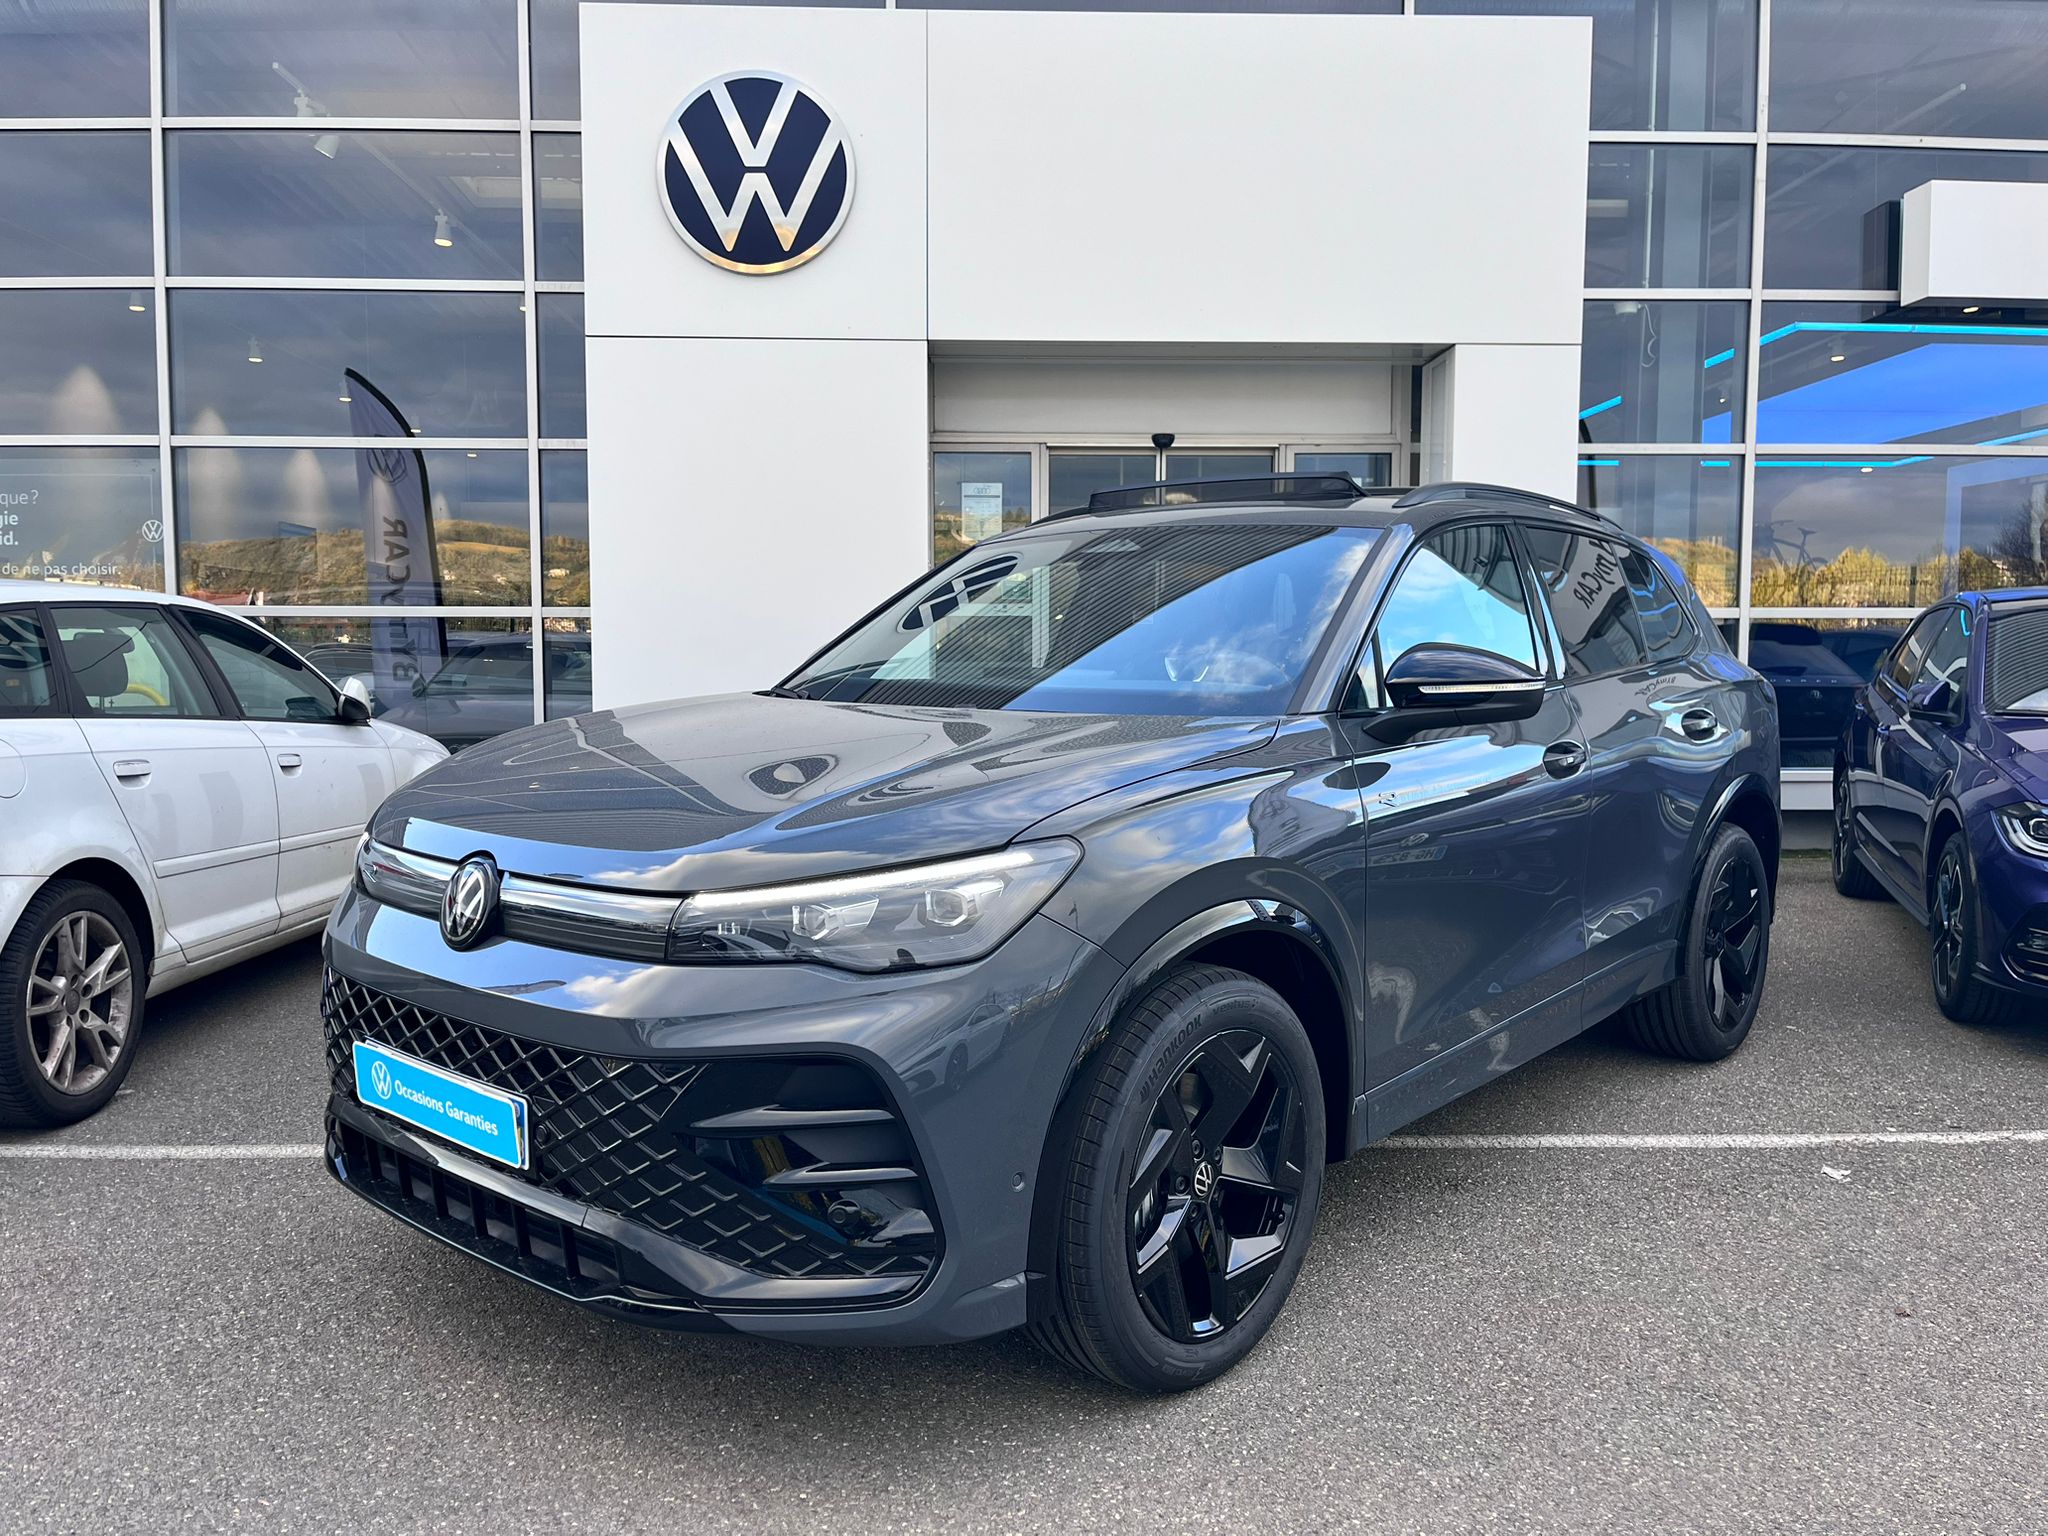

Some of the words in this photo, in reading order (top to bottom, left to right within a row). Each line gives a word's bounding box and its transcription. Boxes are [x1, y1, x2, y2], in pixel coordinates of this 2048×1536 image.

[1, 562, 19, 575] de
[23, 565, 40, 575] ne
[44, 564, 68, 578] pas
[71, 562, 122, 575] choisir.
[394, 1079, 444, 1115] Occasions
[445, 1100, 499, 1137] Garanties
